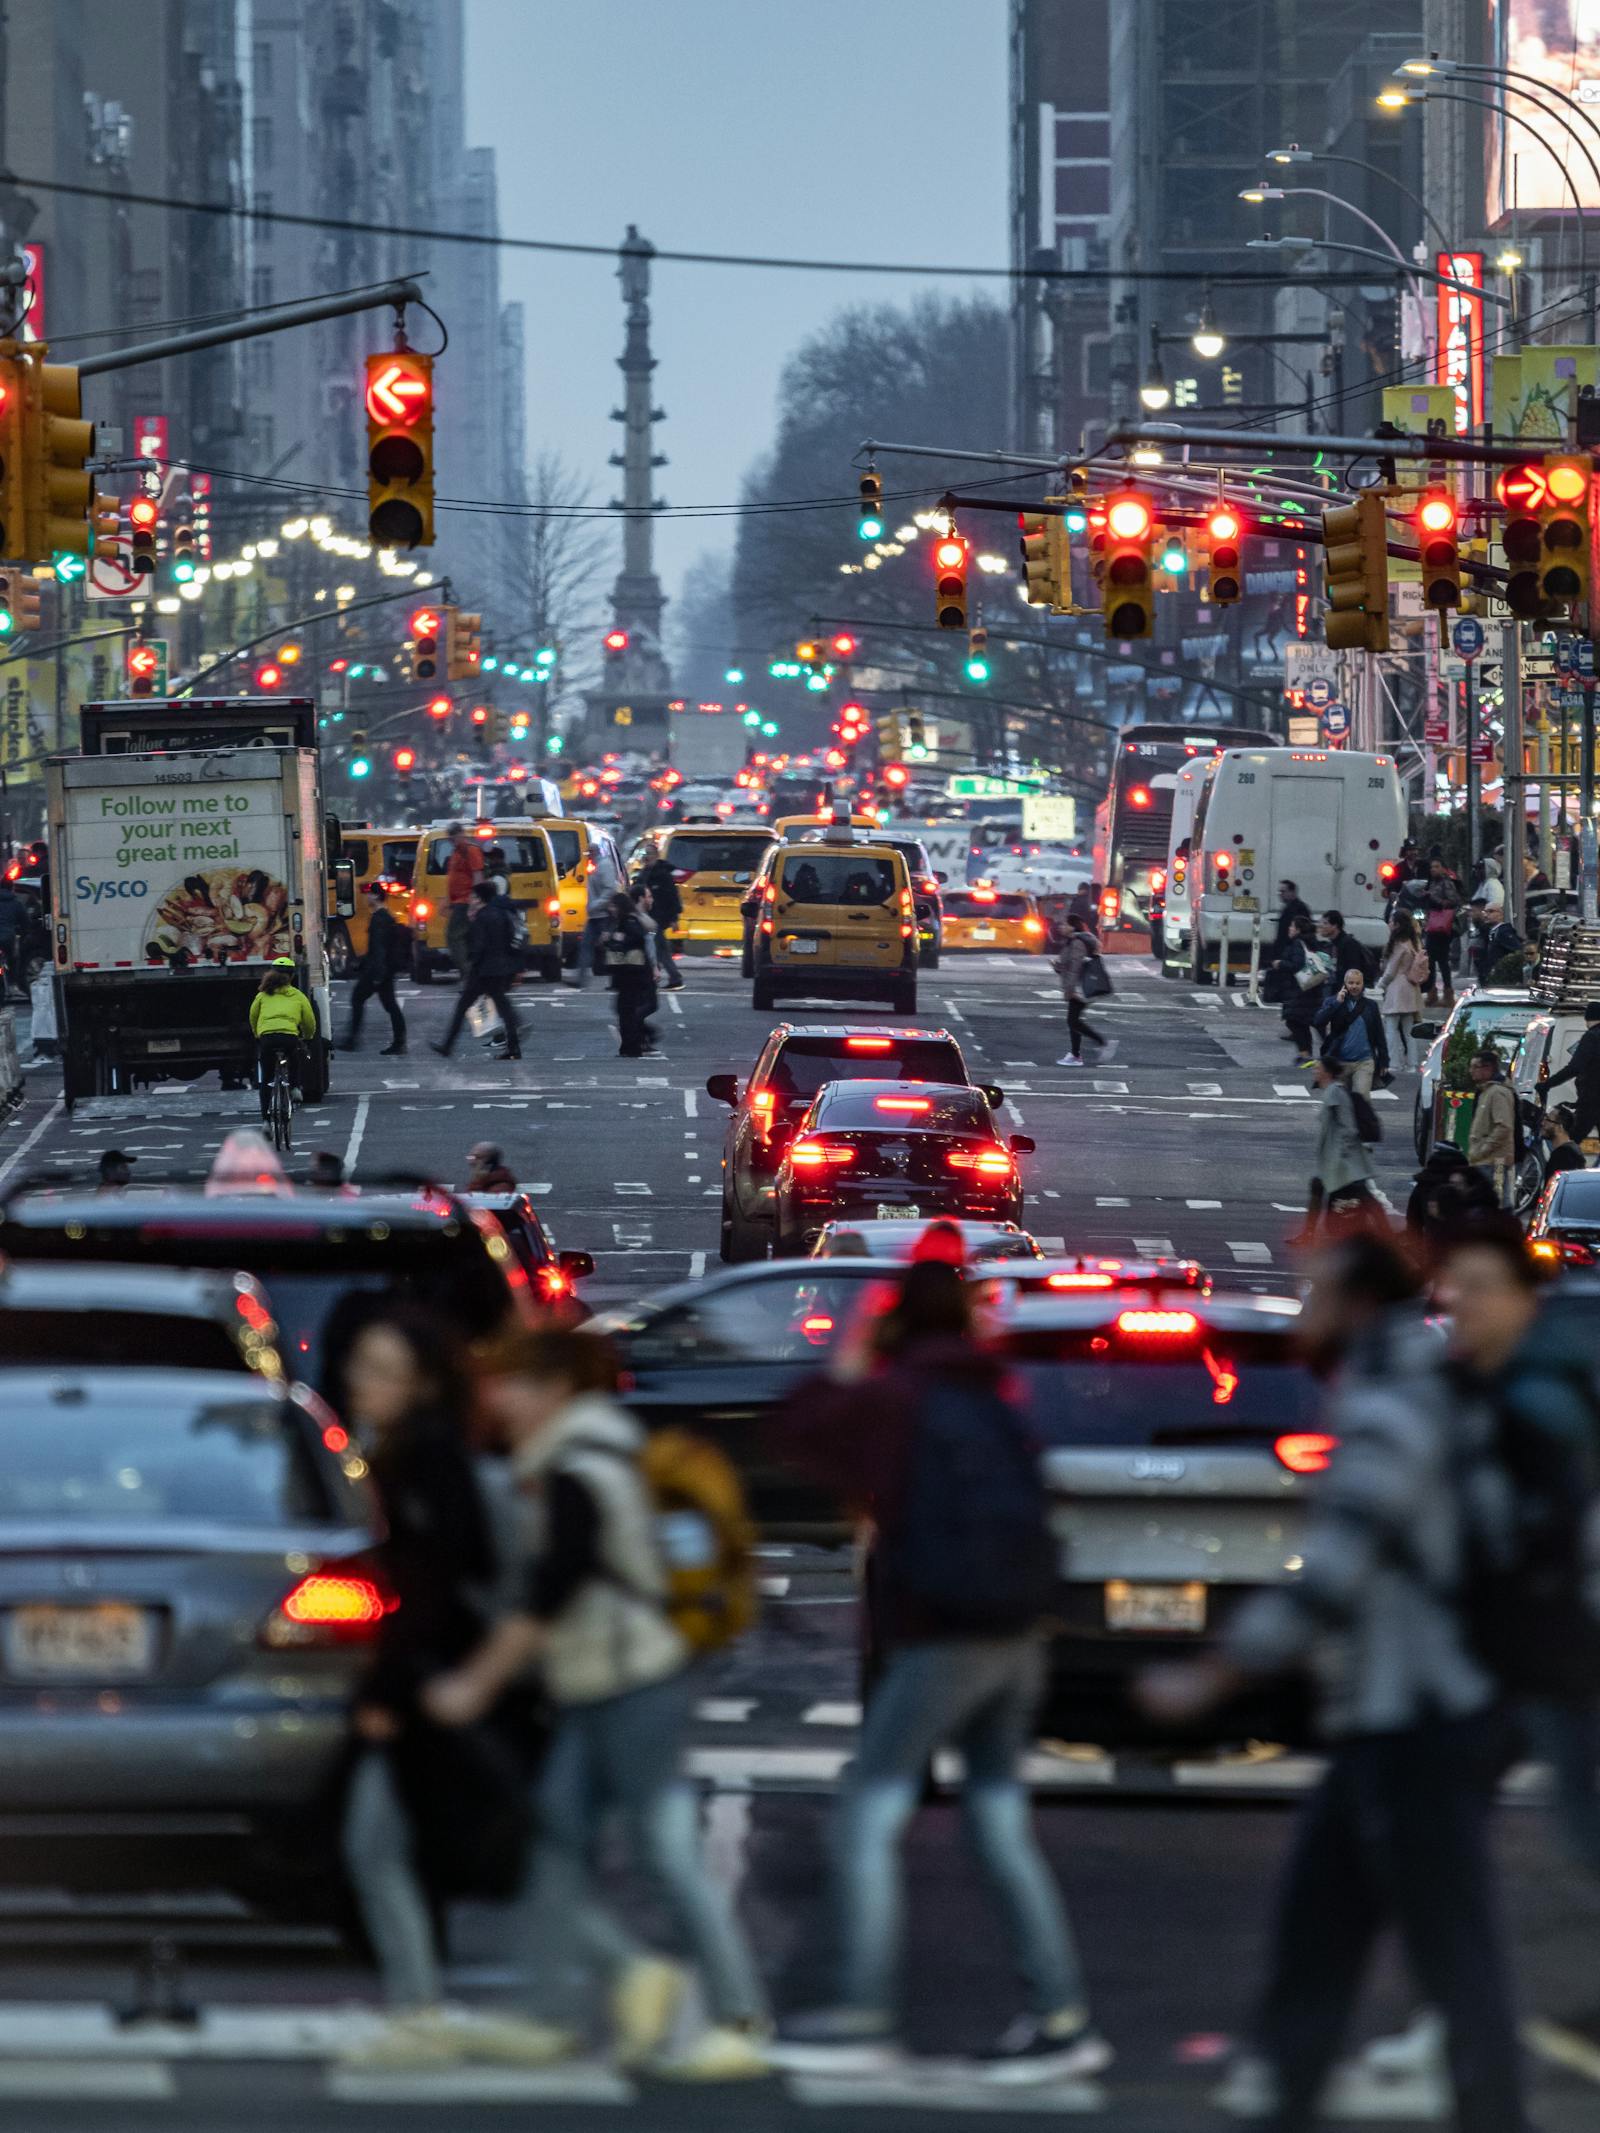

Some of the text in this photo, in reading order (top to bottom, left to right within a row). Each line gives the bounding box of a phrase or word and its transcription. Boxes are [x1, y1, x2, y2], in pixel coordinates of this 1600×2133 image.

[1298, 663, 1328, 673] ONLY
[1237, 772, 1255, 784] 260
[1367, 777, 1385, 789] 260
[101, 794, 249, 817] Follow me to
[121, 817, 231, 844] your next
[116, 838, 240, 867] great meal
[76, 876, 148, 904] Sysco
